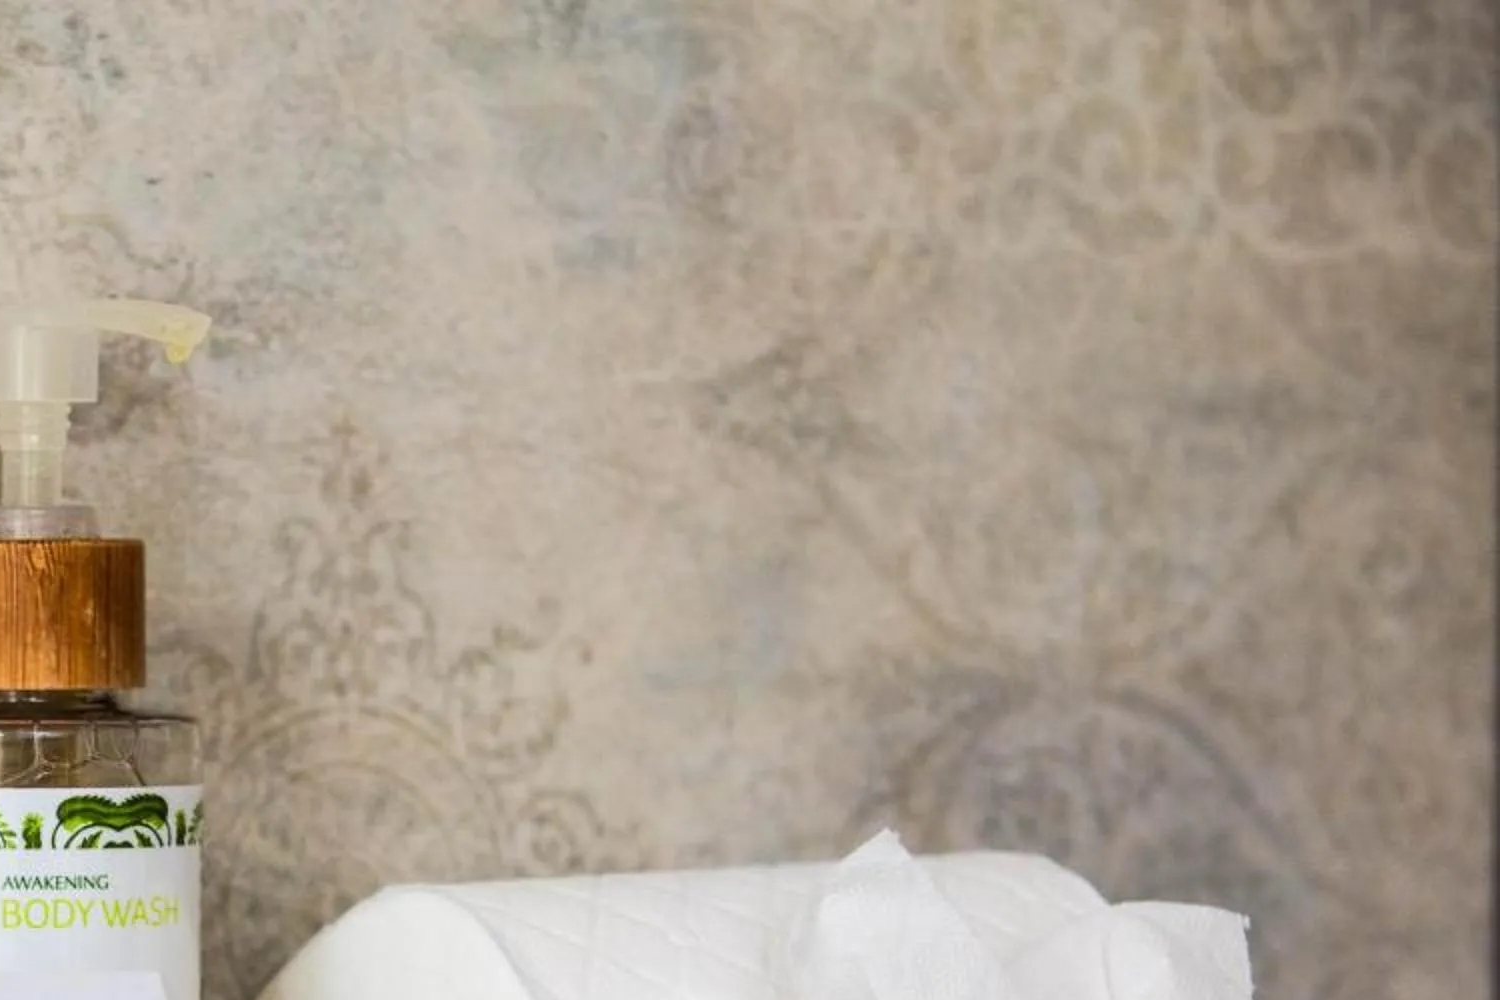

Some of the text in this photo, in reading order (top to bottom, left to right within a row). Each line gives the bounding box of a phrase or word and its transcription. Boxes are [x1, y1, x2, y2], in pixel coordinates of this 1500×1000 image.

[2, 874, 109, 891] AWAKENING
[2, 894, 181, 929] BODY WASH
